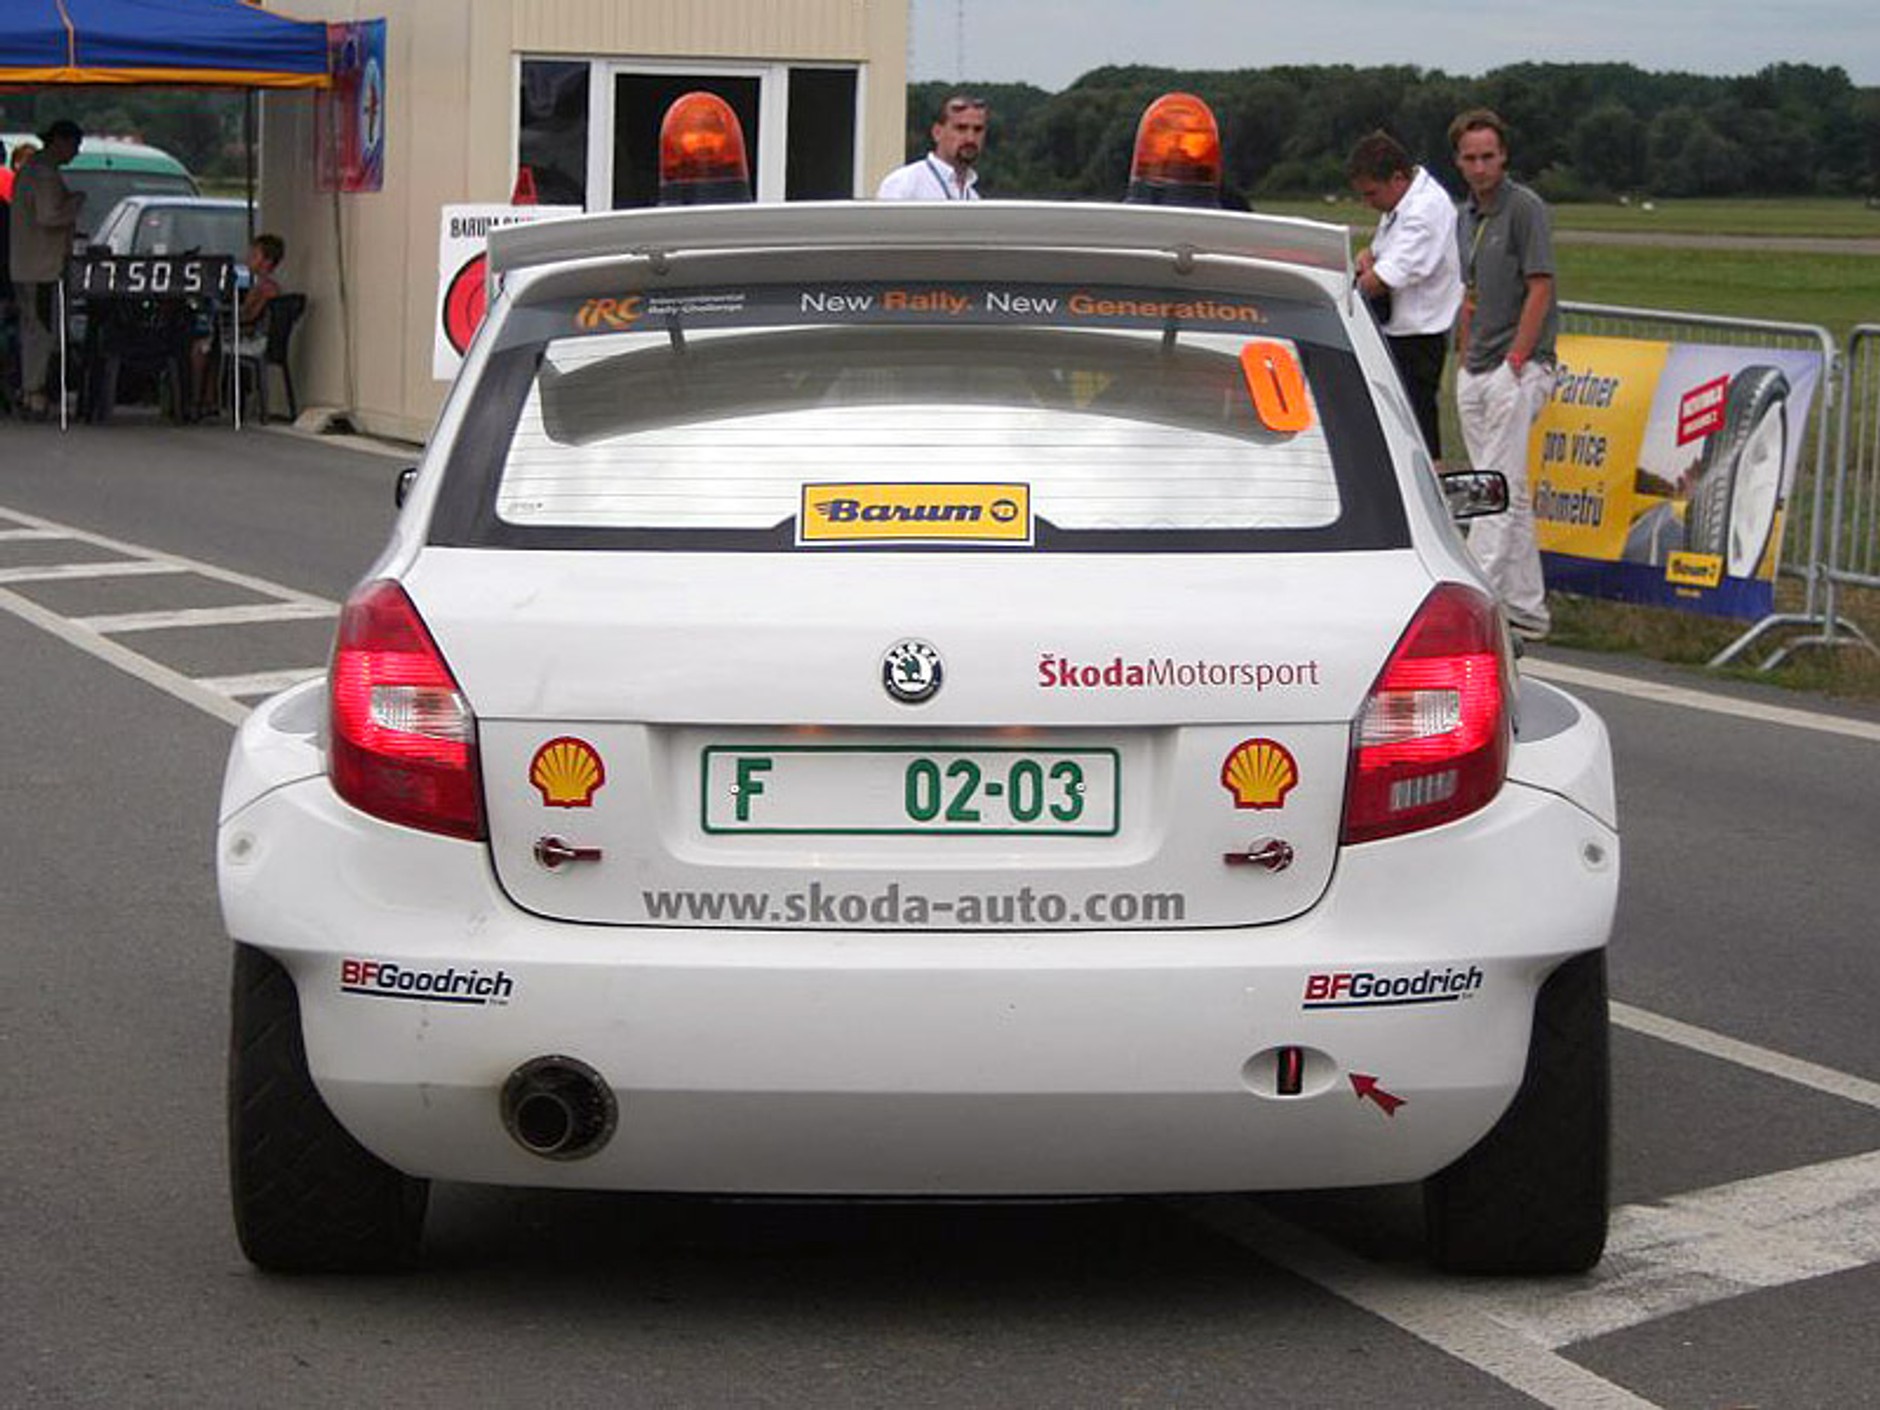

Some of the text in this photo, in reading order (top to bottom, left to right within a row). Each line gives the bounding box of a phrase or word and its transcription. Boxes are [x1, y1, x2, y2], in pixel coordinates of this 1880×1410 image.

[801, 290, 1268, 323] New Rally. New Generation.
[814, 499, 983, 522] Barum
[1038, 652, 1320, 691] ŠkodaMotorsport
[735, 757, 1085, 823] F 02-03
[642, 882, 1186, 925] www.skoda-auto.com
[341, 960, 513, 997] BFGoodrich
[1304, 965, 1483, 1000] BFGoodrich
